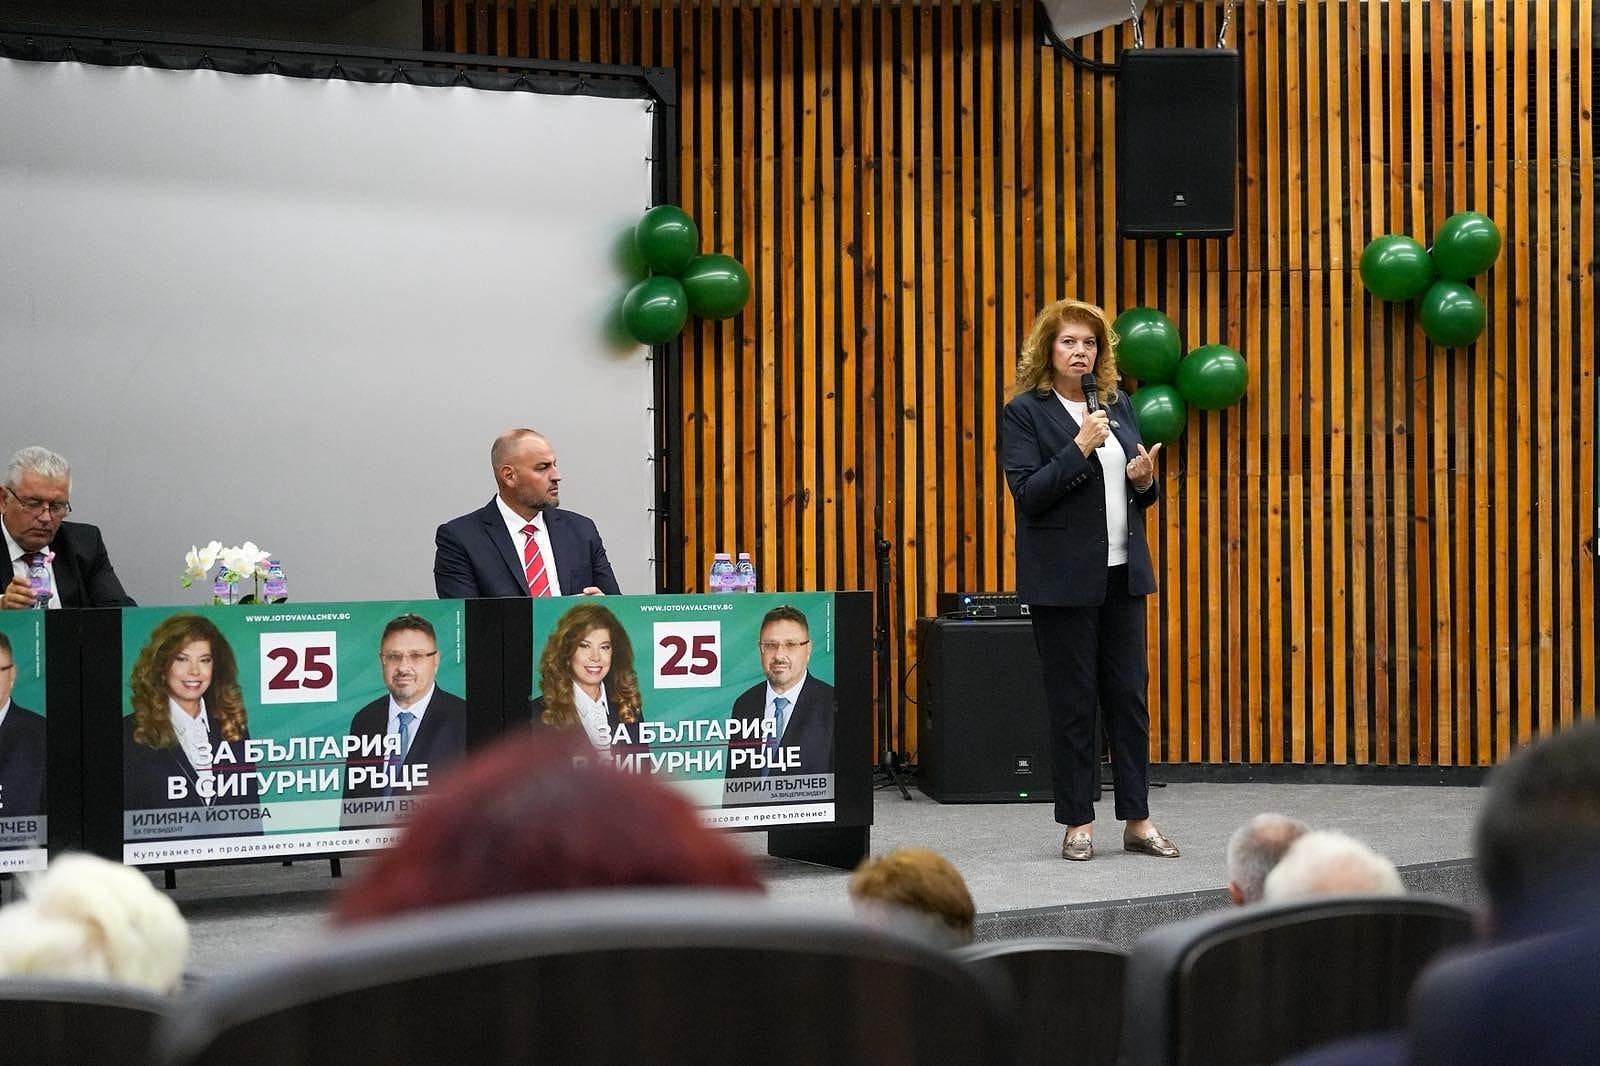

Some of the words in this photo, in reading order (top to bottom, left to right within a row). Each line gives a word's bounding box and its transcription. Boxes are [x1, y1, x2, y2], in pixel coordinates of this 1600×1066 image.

[245, 612, 351, 623] WWW.IOTOVAVALCHEV.BG
[640, 603, 733, 613] WWW.IOTOVAVALCHEV.BG
[658, 634, 719, 676] 25
[265, 645, 334, 690] 25
[596, 723, 633, 746] ЗА
[639, 717, 777, 745] БЪЛГАРИЯ
[195, 739, 238, 766] ЗА
[244, 732, 402, 763] БЪЛГАРИЯ
[730, 745, 801, 772] РЪЦЕ
[167, 775, 187, 801] В
[194, 767, 340, 799] СИГУРНИ
[347, 763, 429, 792] РЪЦЕ
[725, 780, 772, 793] КИРИЛ
[775, 777, 828, 791] ВЪЛЧЕВ
[132, 811, 201, 827] ИЛИЯНА
[205, 806, 272, 822] ЙОТОВА
[343, 800, 395, 815] КИРИЛ
[753, 810, 827, 822] престъпление!
[133, 847, 202, 860] Купуването
[207, 846, 214, 854] и
[219, 840, 295, 855] продаването
[299, 840, 312, 848] на
[316, 837, 360, 847] гласове
[364, 836, 371, 844] е
